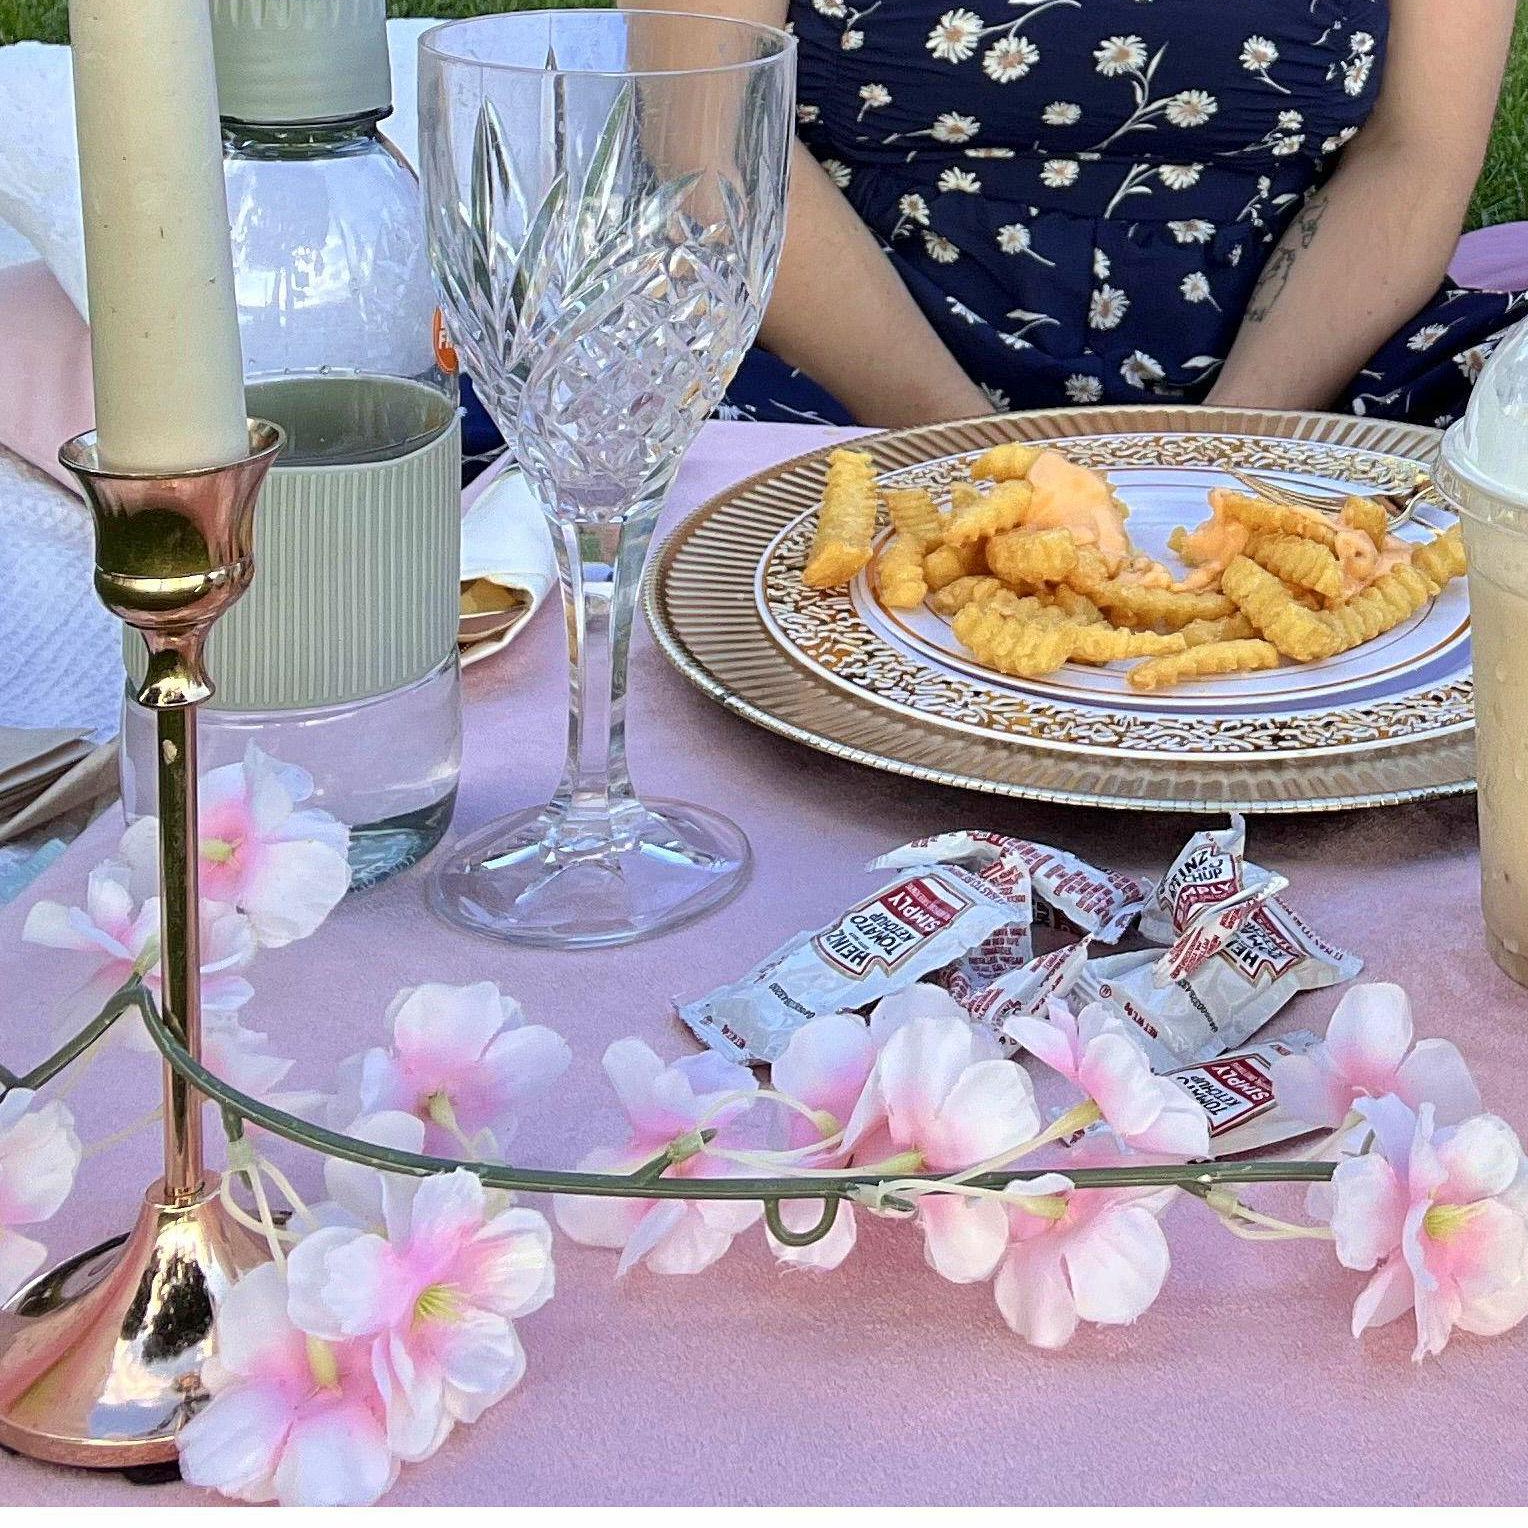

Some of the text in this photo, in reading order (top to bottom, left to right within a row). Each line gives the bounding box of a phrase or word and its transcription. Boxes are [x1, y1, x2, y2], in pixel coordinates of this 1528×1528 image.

[868, 912, 916, 943] KETCHUP
[888, 891, 941, 934] SIMPLY
[825, 929, 871, 966] HEINZ
[850, 915, 903, 957] TOMATO
[1225, 939, 1259, 968] HEI
[1190, 1075, 1241, 1109] KETCHUP
[1211, 1065, 1270, 1102] SIMPLY
